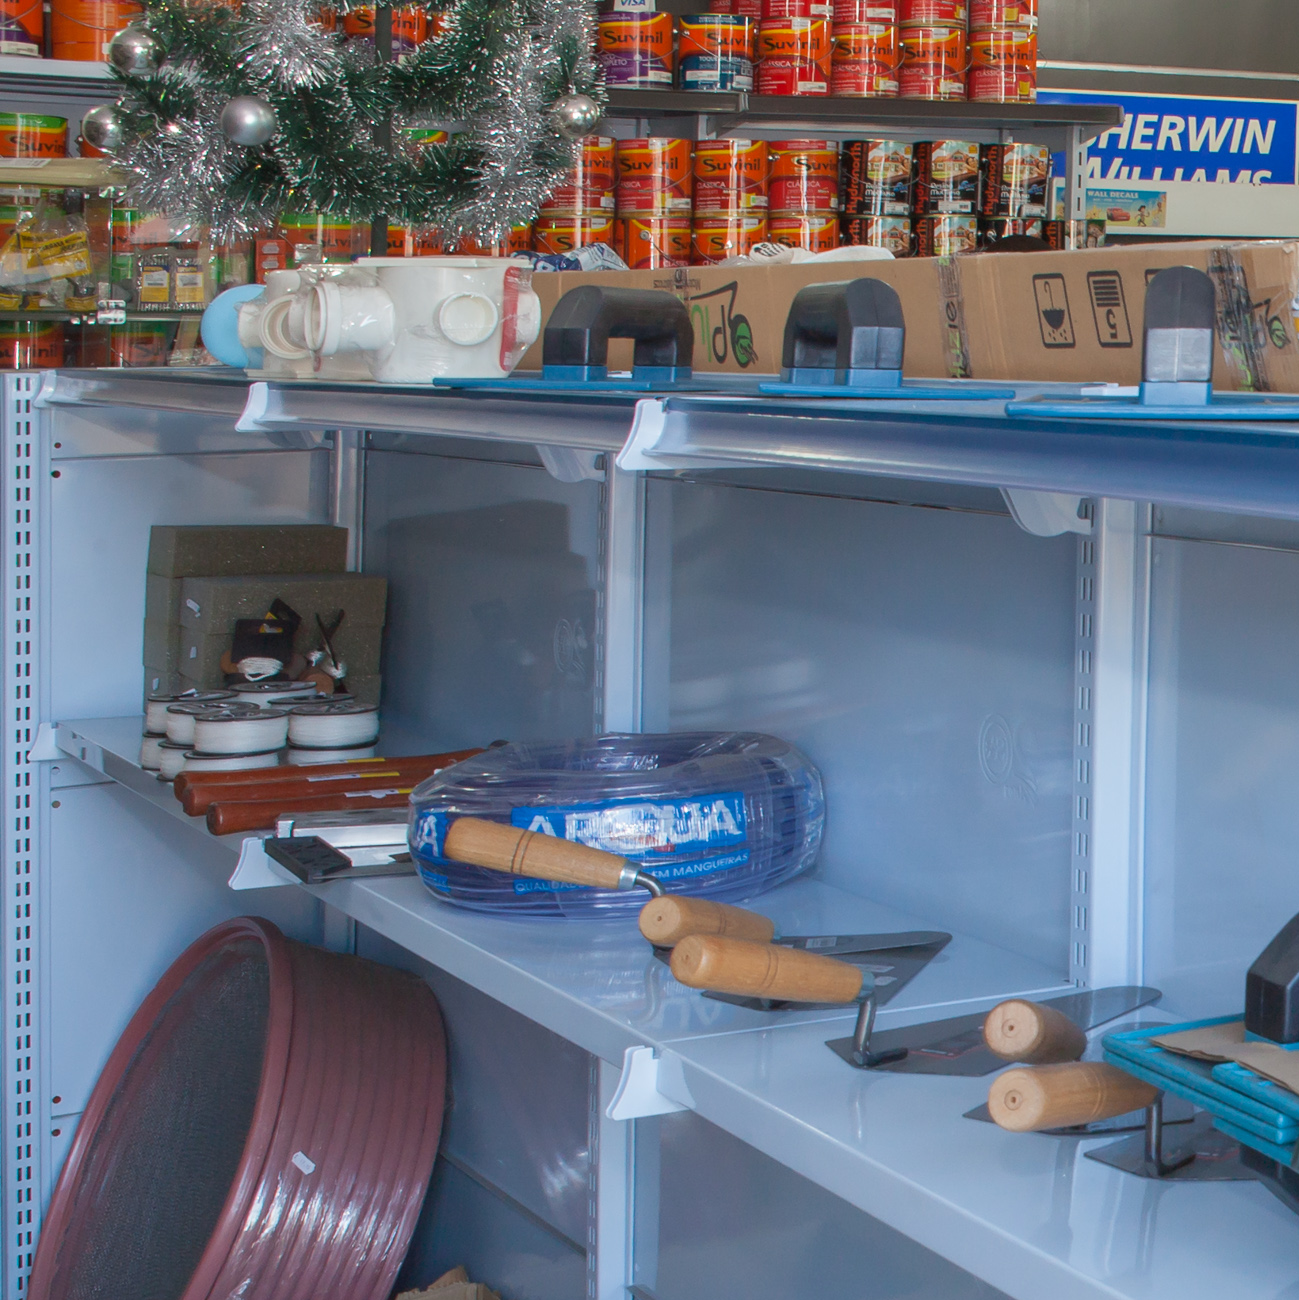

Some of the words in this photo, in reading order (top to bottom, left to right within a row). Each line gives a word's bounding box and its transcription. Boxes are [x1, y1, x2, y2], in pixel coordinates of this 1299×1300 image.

[604, 30, 663, 45] Suvinil
[763, 38, 820, 51] Suvinil
[837, 41, 893, 56] Suvinil
[903, 46, 958, 59] Suvinil
[982, 48, 1033, 61] Suvinil
[1090, 113, 1276, 154] HERWIN
[620, 157, 678, 172] Suvinil
[703, 157, 761, 172] Suvinil
[671, 852, 749, 877] MANGUEIRAS
